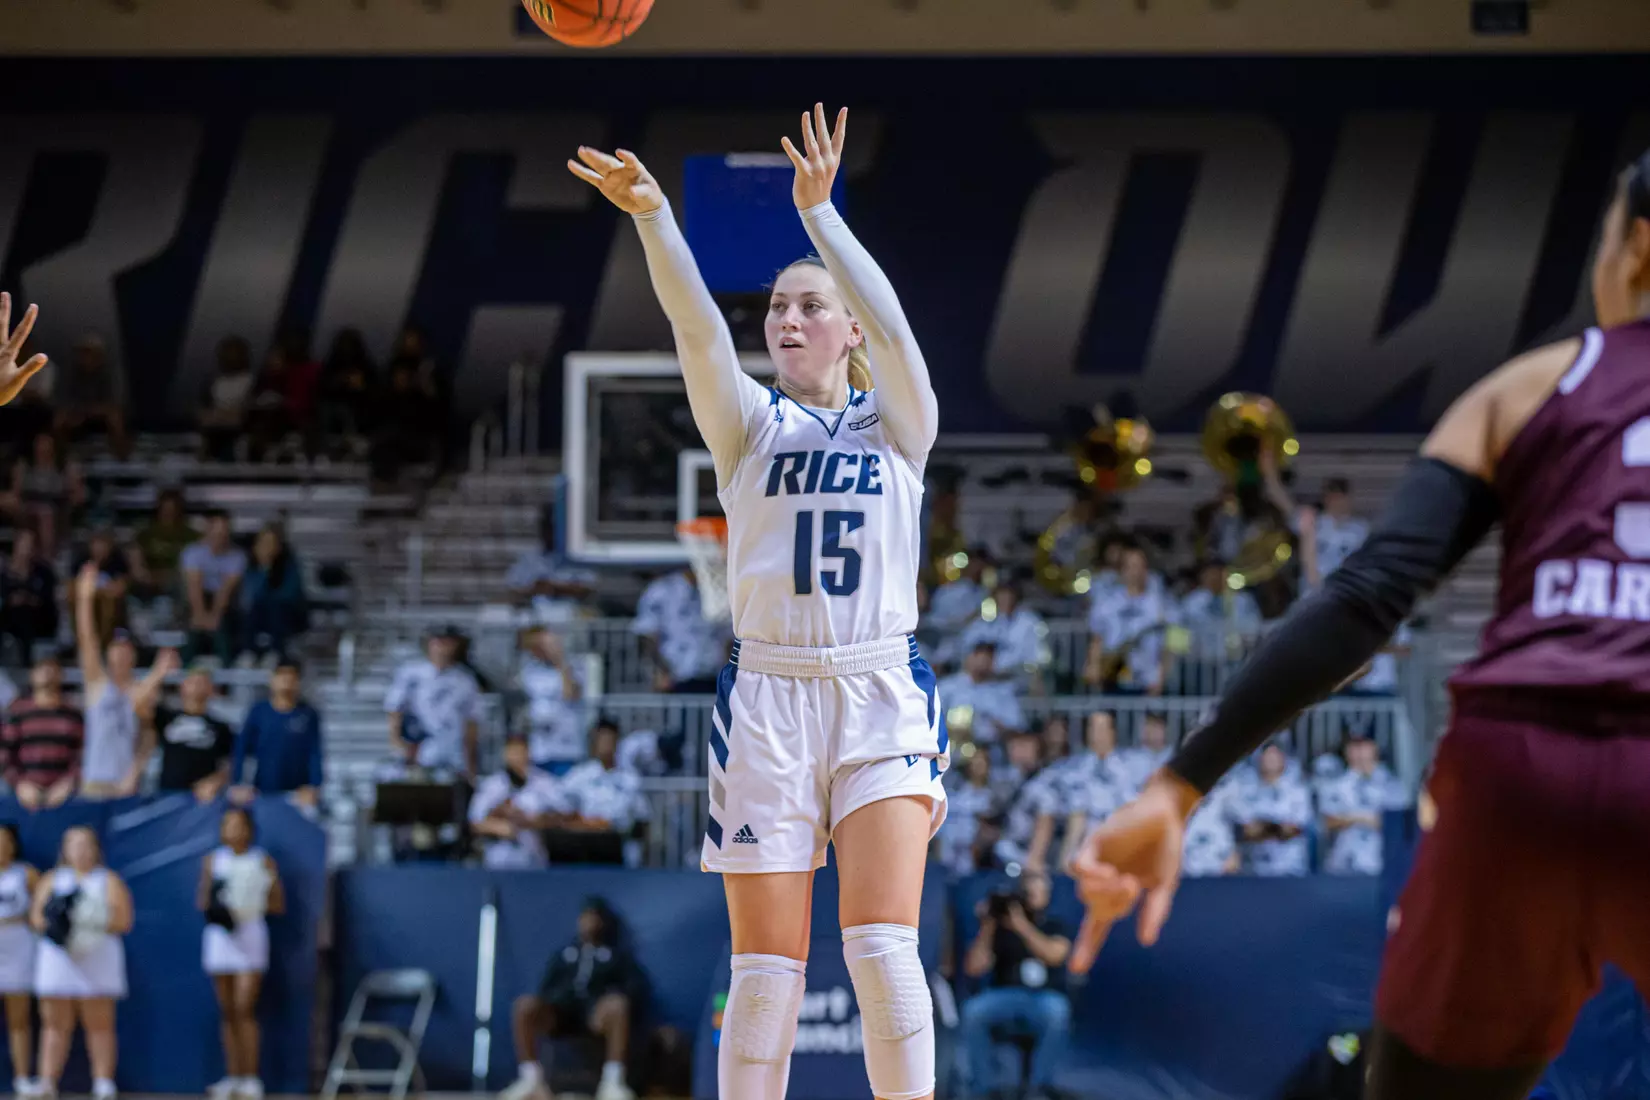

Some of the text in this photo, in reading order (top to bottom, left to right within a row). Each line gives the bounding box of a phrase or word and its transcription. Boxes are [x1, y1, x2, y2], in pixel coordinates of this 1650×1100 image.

[765, 450, 883, 497] RICE
[793, 510, 865, 596] 15
[732, 836, 758, 844] adidas
